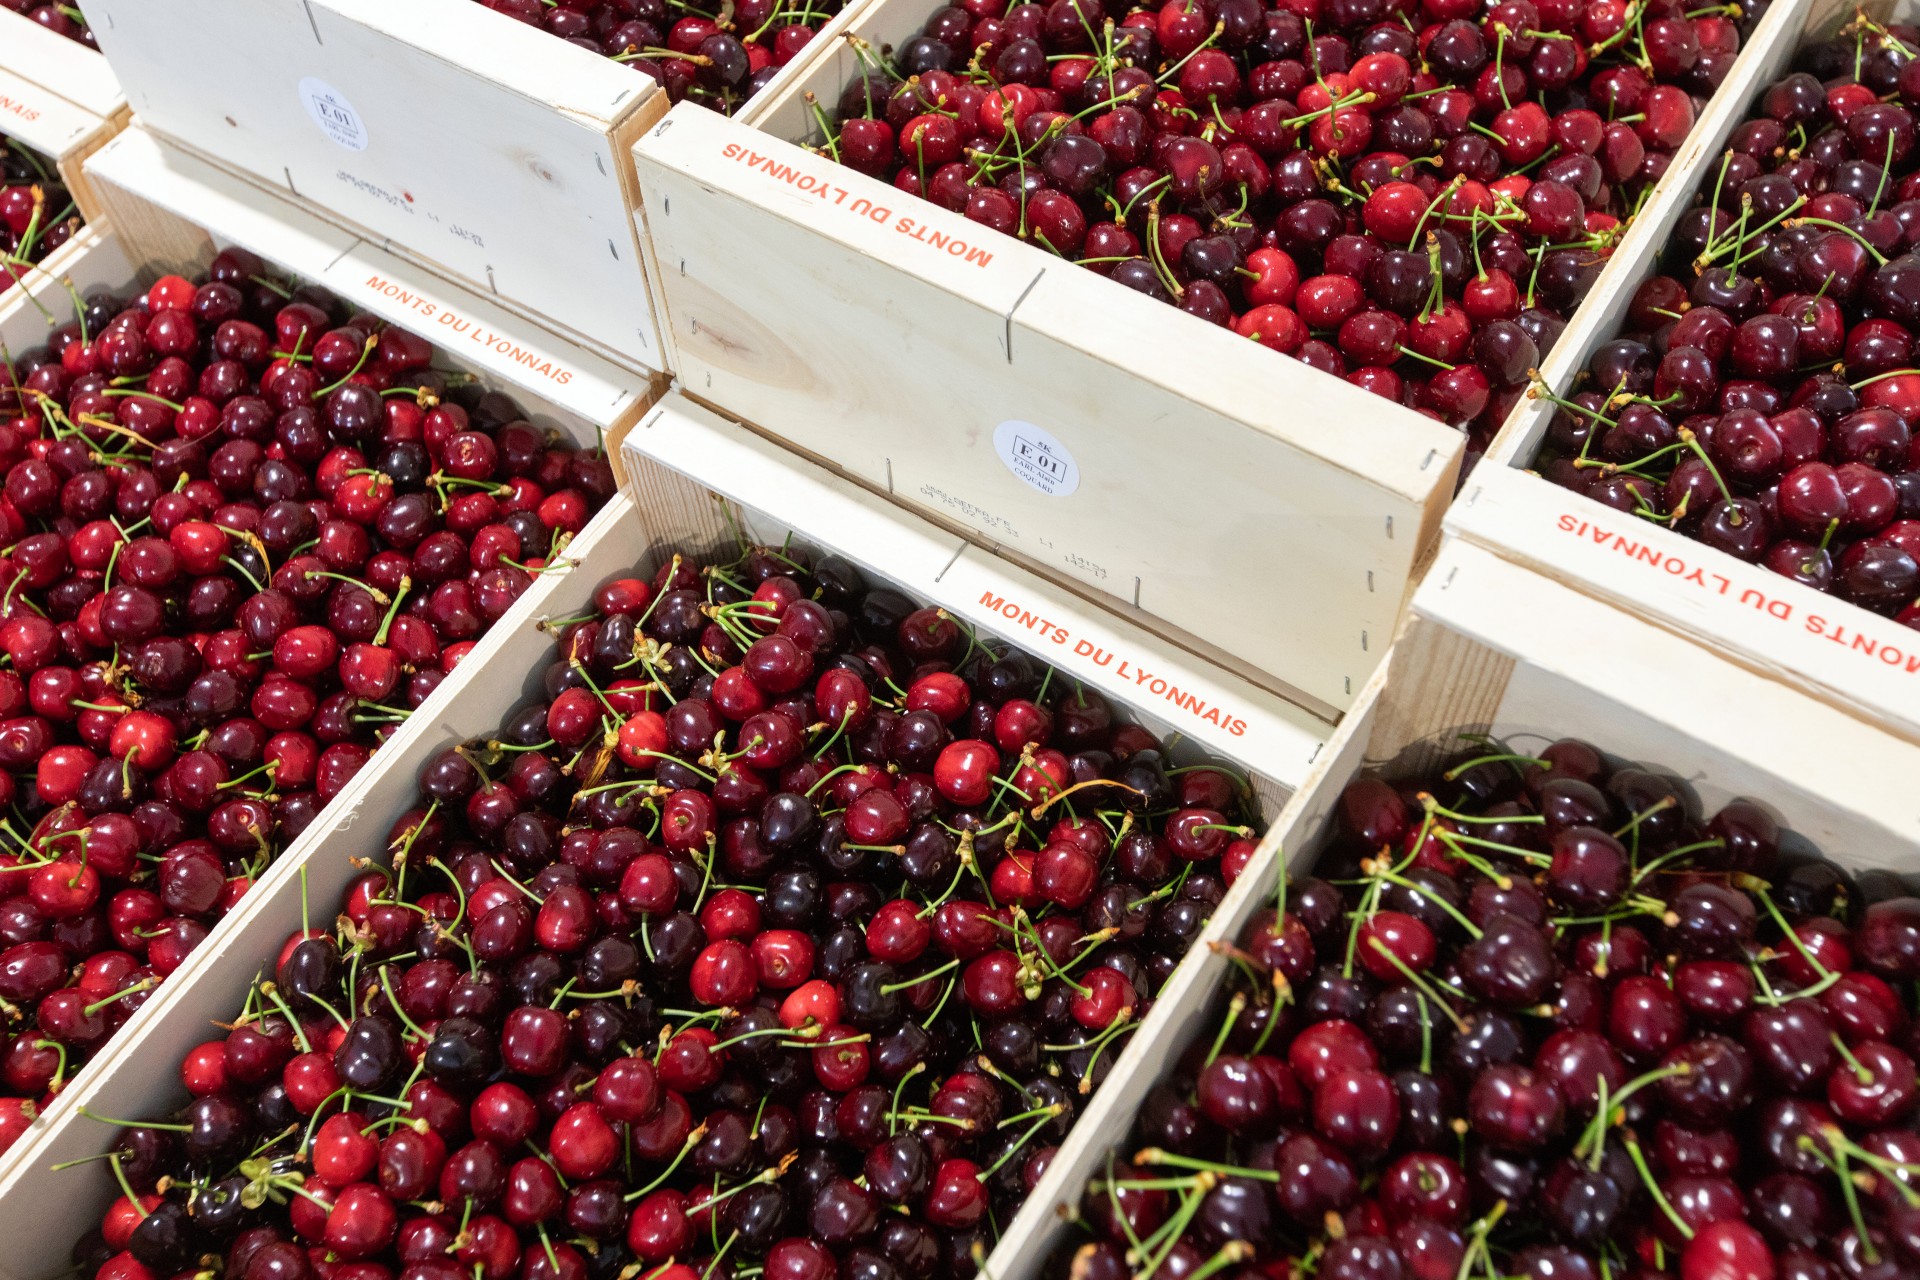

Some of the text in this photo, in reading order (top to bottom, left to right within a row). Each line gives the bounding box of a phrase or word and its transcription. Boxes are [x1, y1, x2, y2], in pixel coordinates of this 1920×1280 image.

[721, 143, 993, 269] MONTS DU LYONNAIS
[366, 276, 573, 385] MONTS DU LYONNAIS
[1014, 457, 1055, 486] EARL Alain
[1014, 467, 1053, 494] COQUARD
[1020, 443, 1057, 473] E 01
[1556, 514, 1732, 596] LYONNAIS
[1739, 588, 1793, 622] DU
[978, 591, 1248, 737] MONTS DU LYONNAIS
